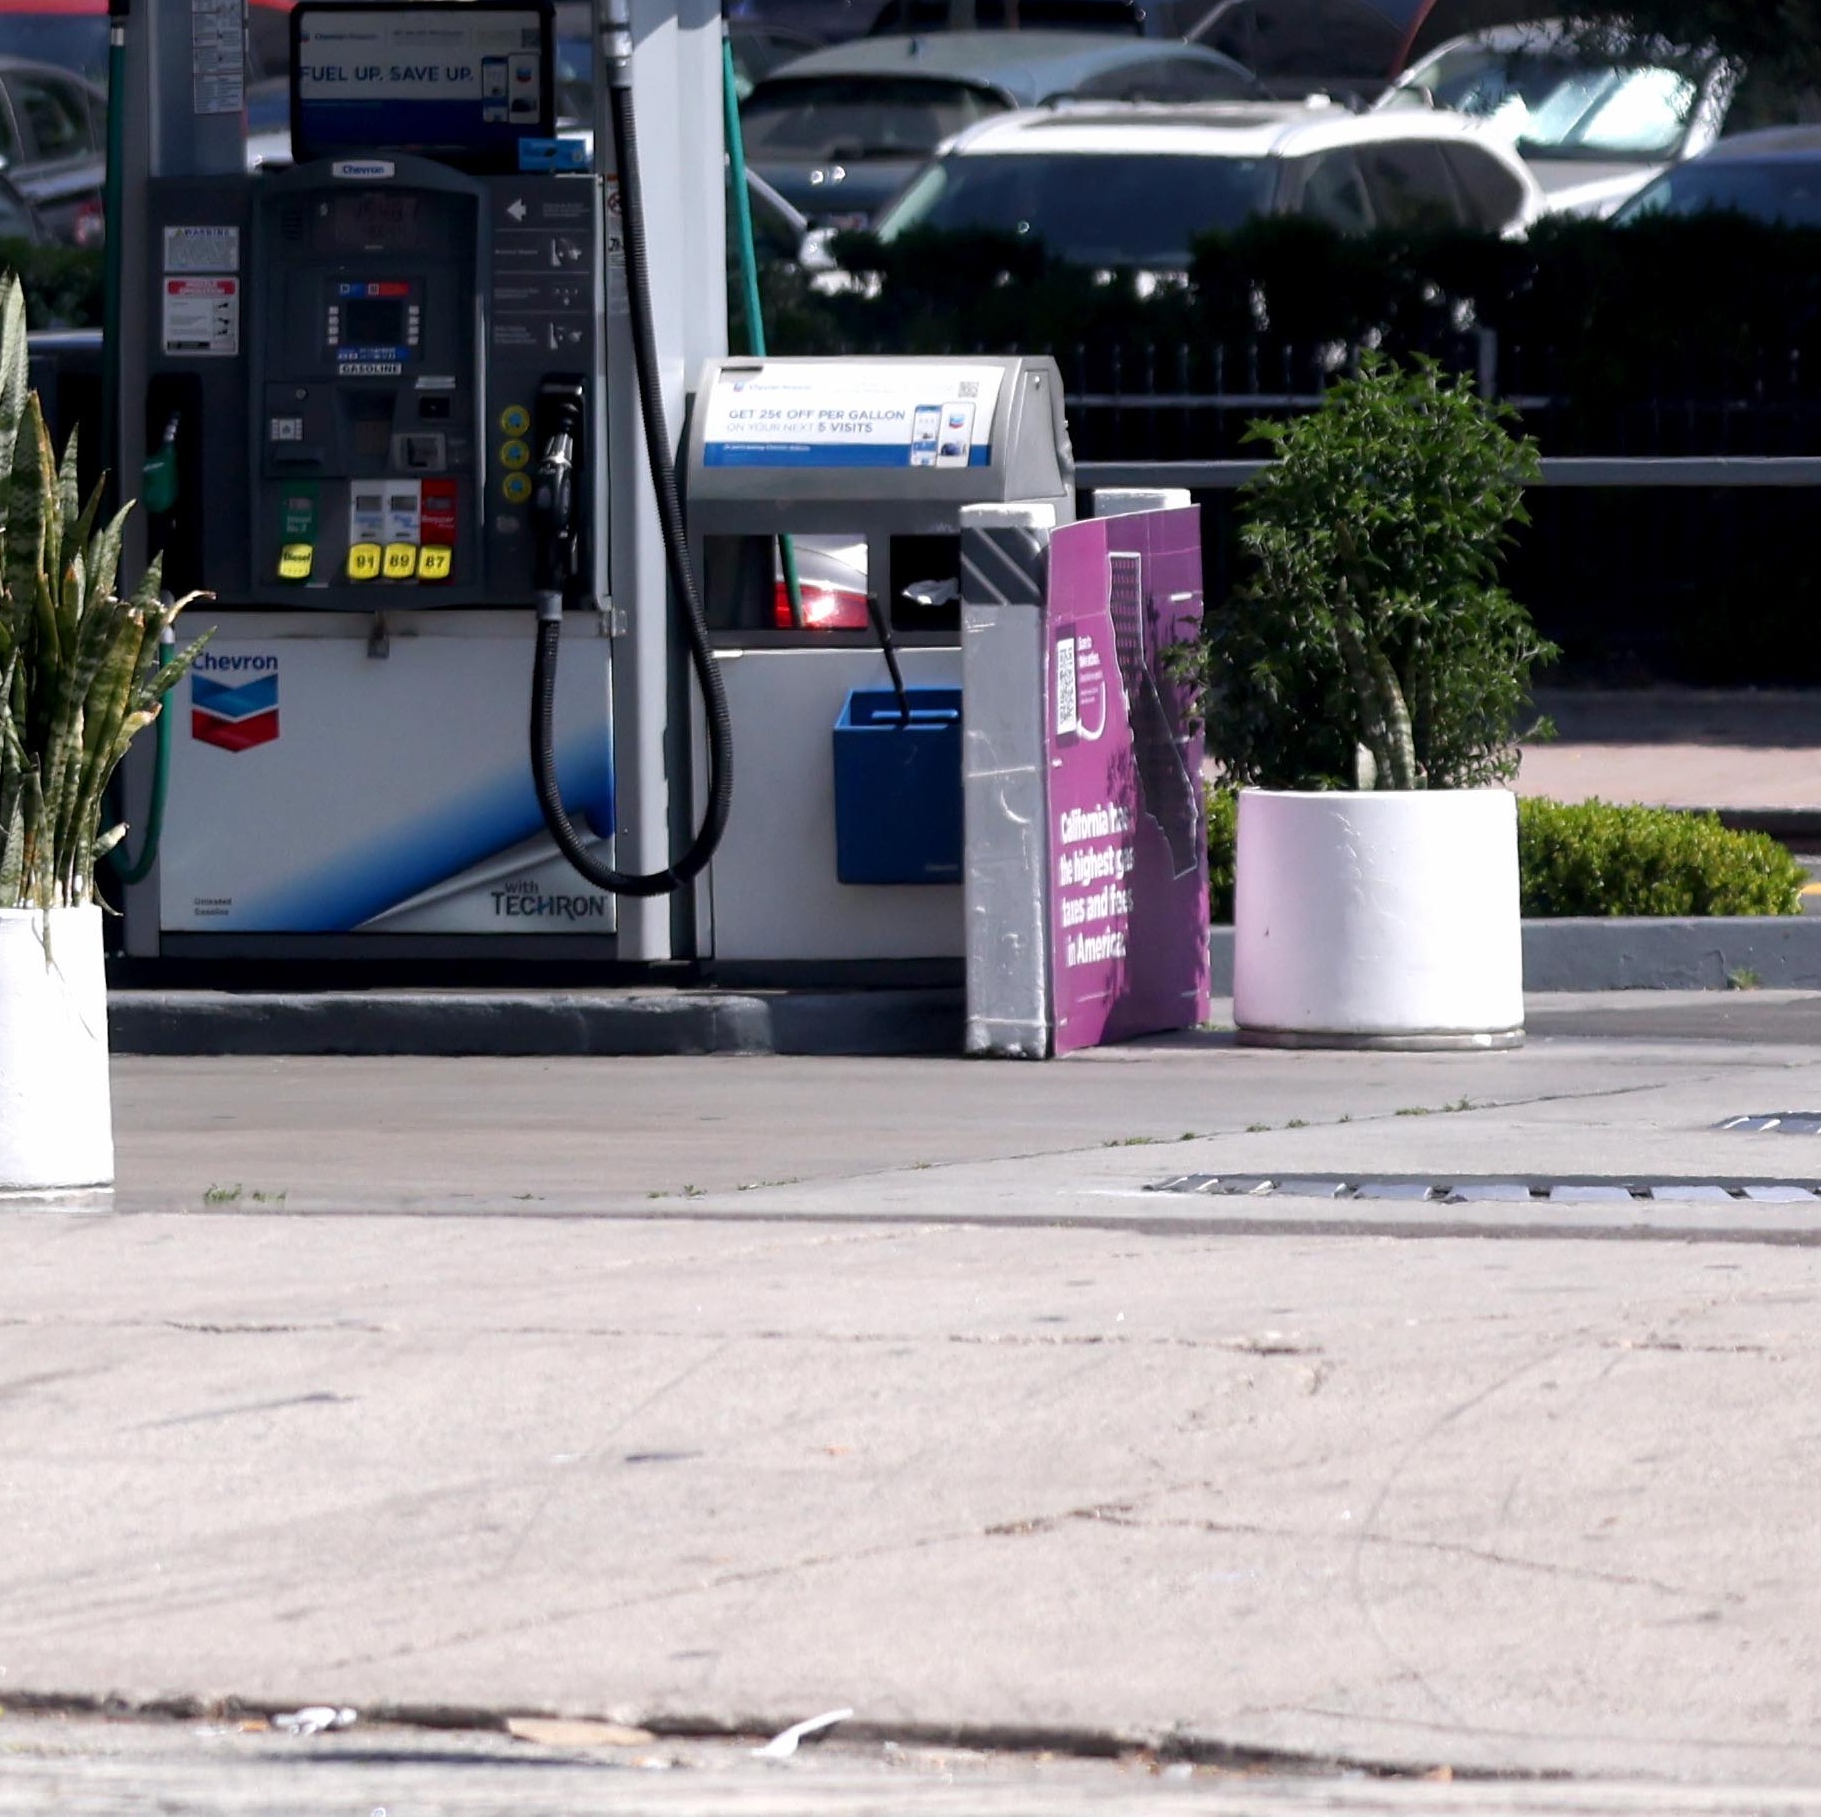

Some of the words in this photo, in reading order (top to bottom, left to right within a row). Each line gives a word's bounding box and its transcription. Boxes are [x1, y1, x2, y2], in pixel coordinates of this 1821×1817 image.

[355, 66, 384, 82] UP.
[390, 66, 439, 82] SAVE
[446, 66, 474, 82] UP.
[729, 409, 756, 420] GET
[787, 409, 814, 419] OFF
[818, 410, 845, 420] PER
[849, 409, 907, 421] GALLON
[748, 422, 781, 432] YOUR
[783, 423, 814, 433] NEXT
[818, 422, 827, 433] 5
[830, 422, 874, 434] VISITS
[357, 555, 375, 568] 91
[389, 555, 410, 567] 89
[425, 555, 445, 568] 87
[192, 651, 278, 671] Chevron
[1060, 803, 1107, 845] California
[1074, 844, 1115, 887] highest
[505, 880, 540, 894] with
[490, 892, 603, 921] TECHRON
[1062, 896, 1085, 927] taxes
[1086, 884, 1108, 922] and
[1077, 924, 1127, 965] America.
